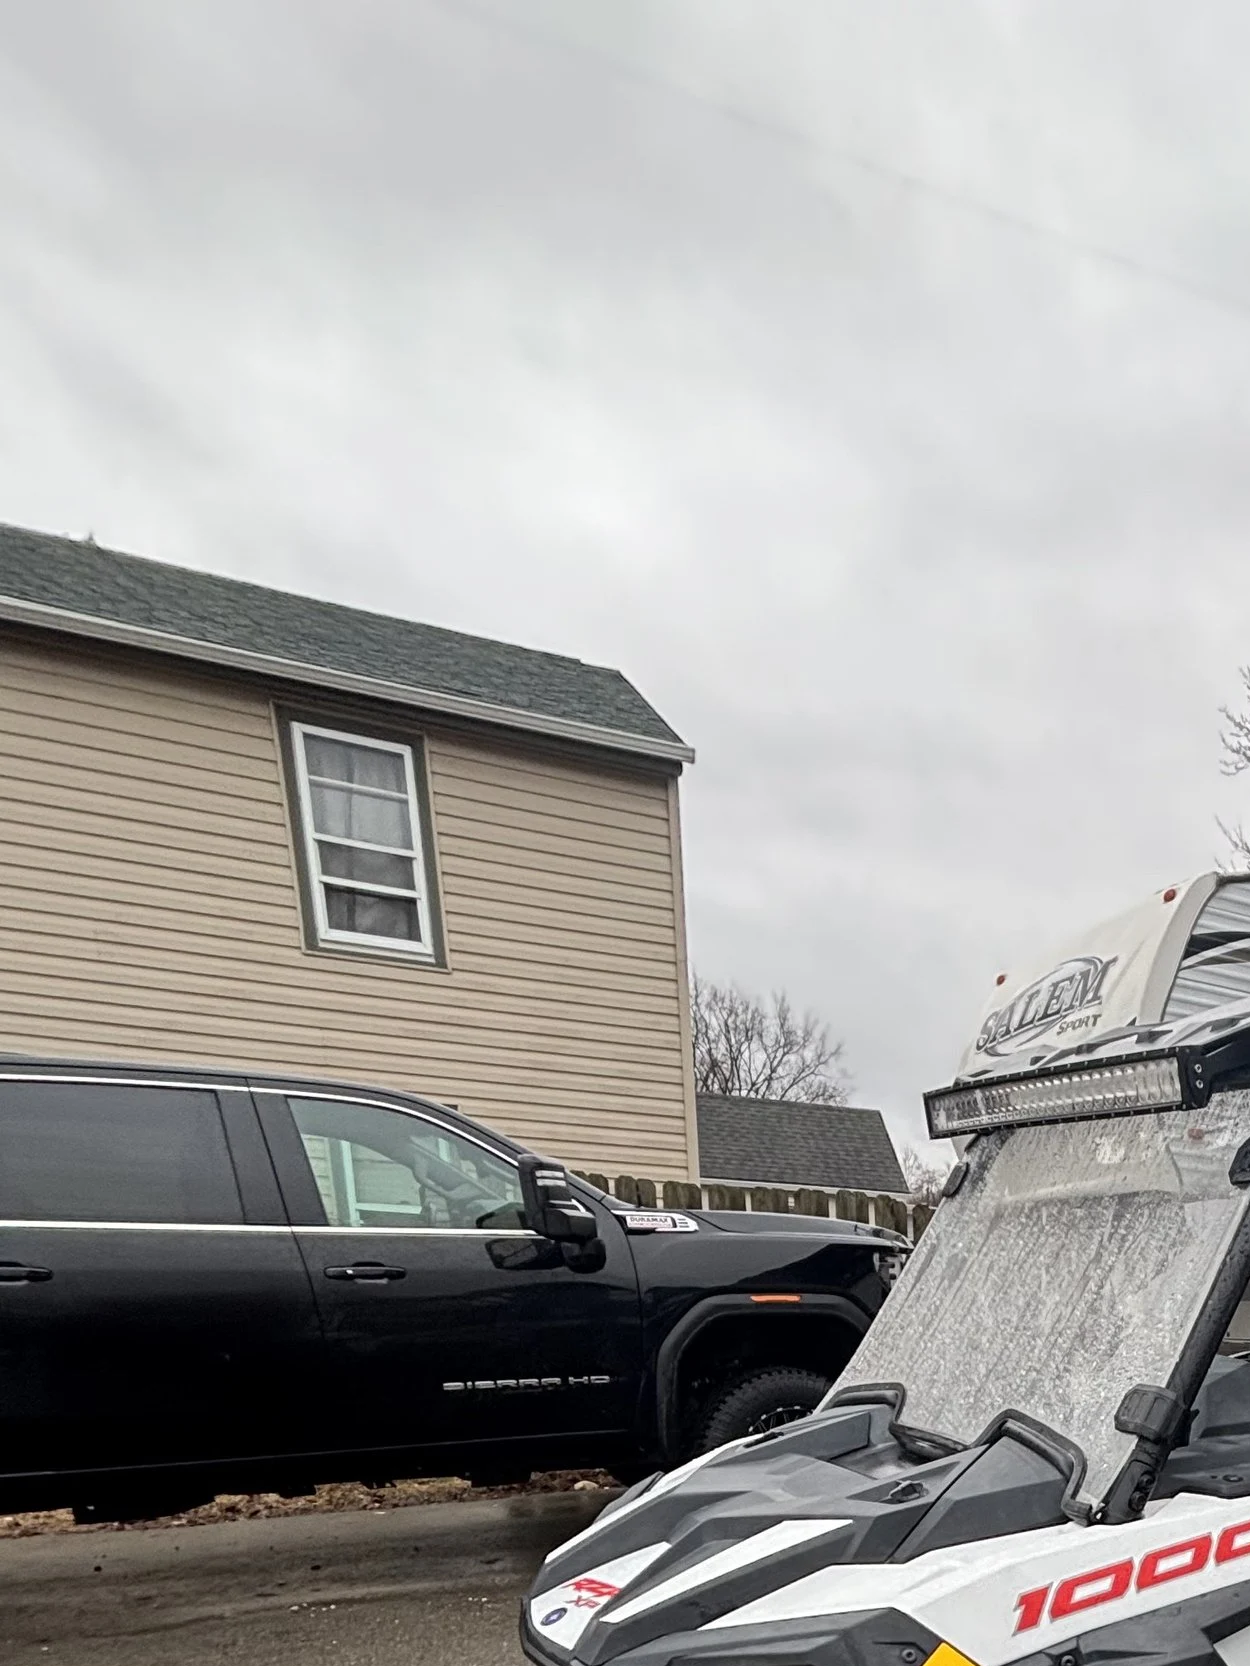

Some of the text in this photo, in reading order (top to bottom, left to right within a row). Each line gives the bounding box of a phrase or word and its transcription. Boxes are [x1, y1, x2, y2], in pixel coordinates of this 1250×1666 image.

[976, 956, 1118, 1051] SALEM
[1057, 1014, 1102, 1036] SPORT
[443, 1375, 610, 1391] SIERRA HD
